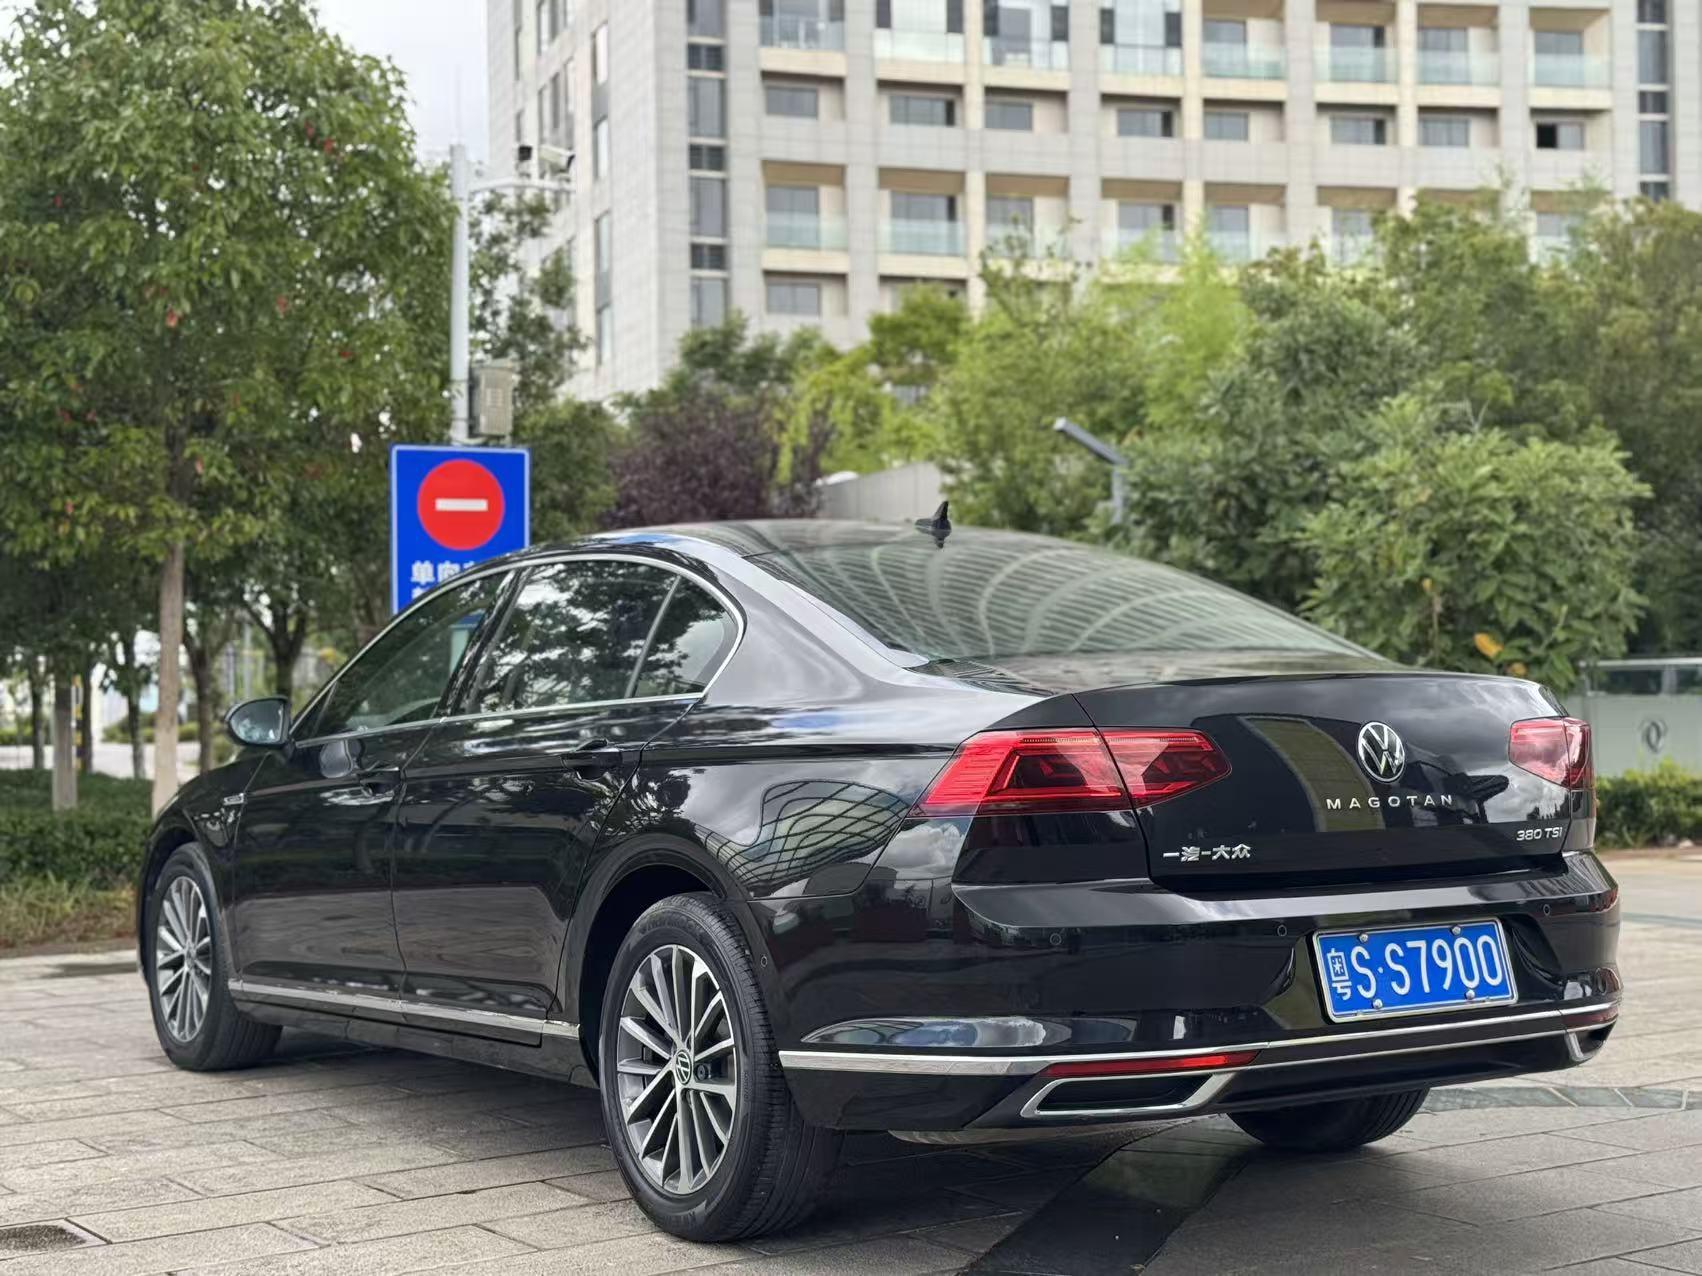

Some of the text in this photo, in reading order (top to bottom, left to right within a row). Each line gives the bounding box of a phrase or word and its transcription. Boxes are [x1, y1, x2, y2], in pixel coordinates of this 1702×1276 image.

[410, 560, 475, 585] 单向
[1326, 794, 1453, 810] MAGOTAN
[1516, 826, 1563, 841] 380 TSI
